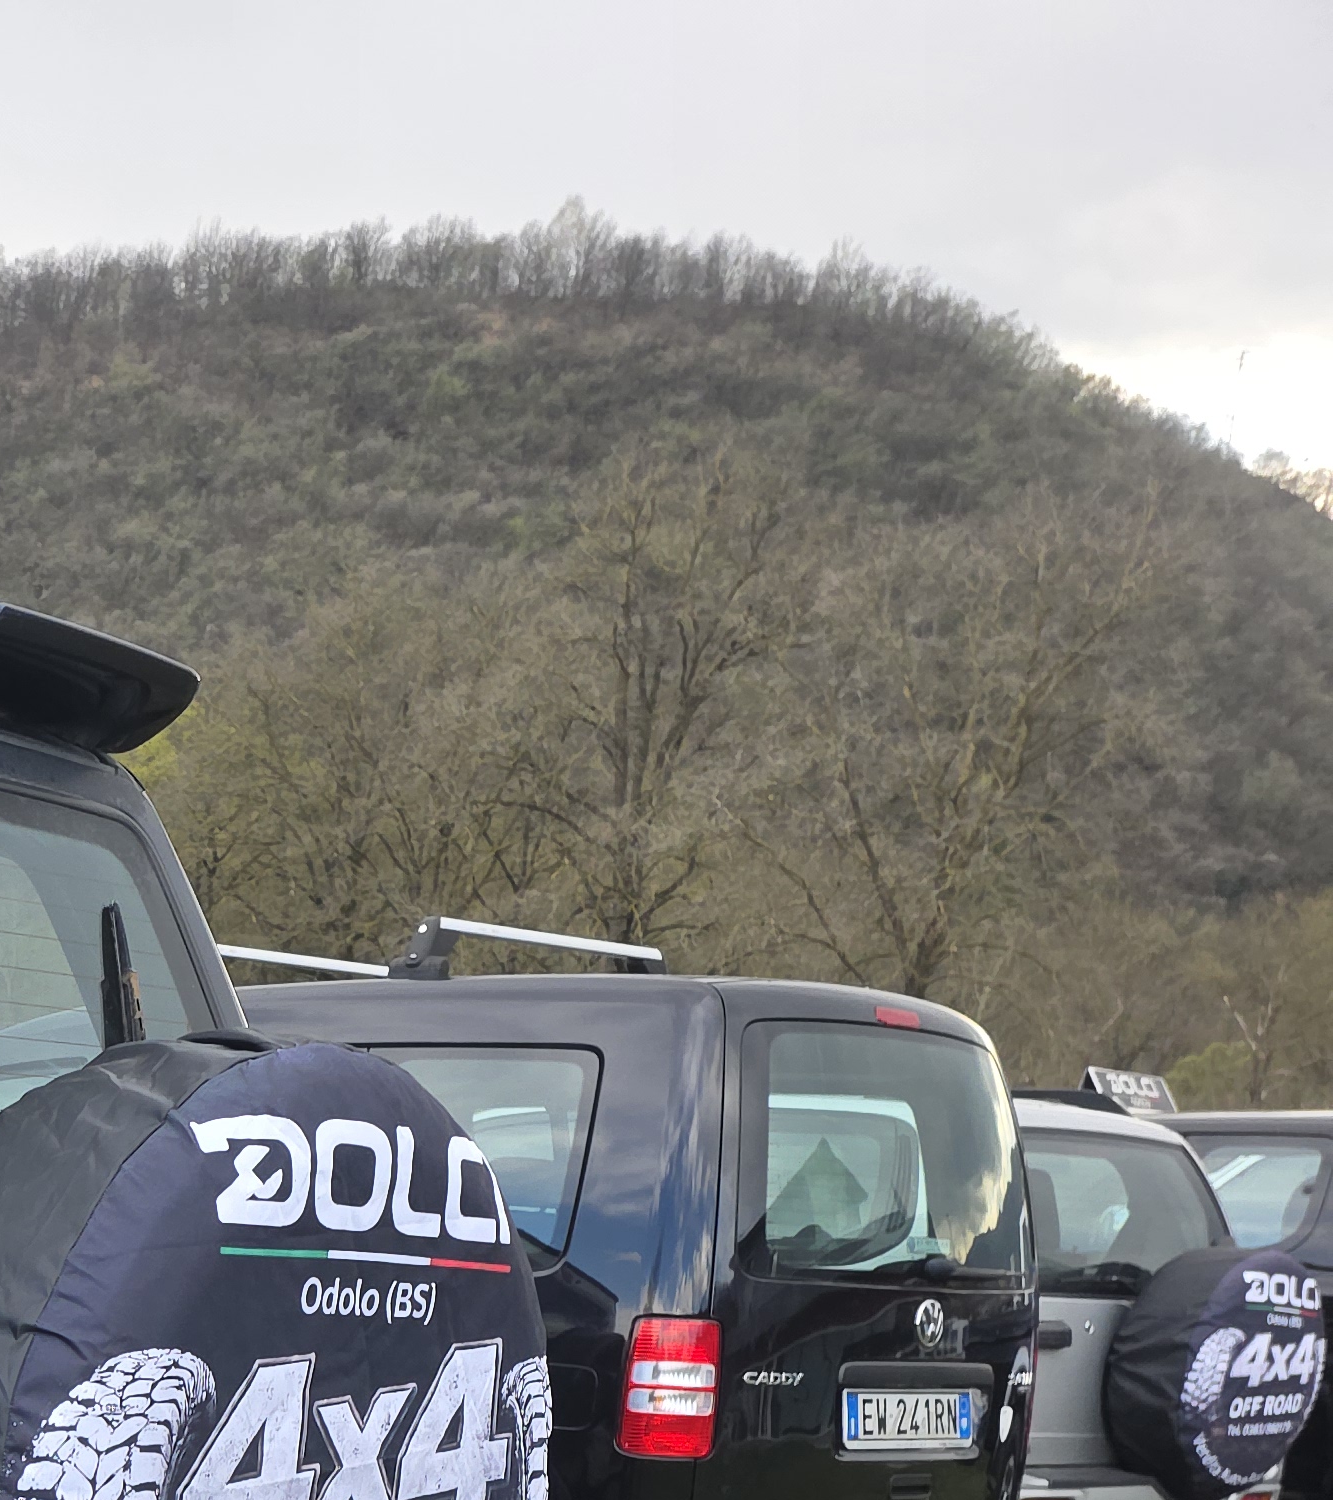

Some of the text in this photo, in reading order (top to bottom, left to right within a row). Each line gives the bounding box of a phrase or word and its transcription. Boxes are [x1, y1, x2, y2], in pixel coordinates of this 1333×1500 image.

[301, 1277, 436, 1326] Odolo (BS)
[1230, 1332, 1317, 1388] 4x4
[742, 1371, 804, 1387] CADDY
[1229, 1393, 1304, 1419] OFF ROAD
